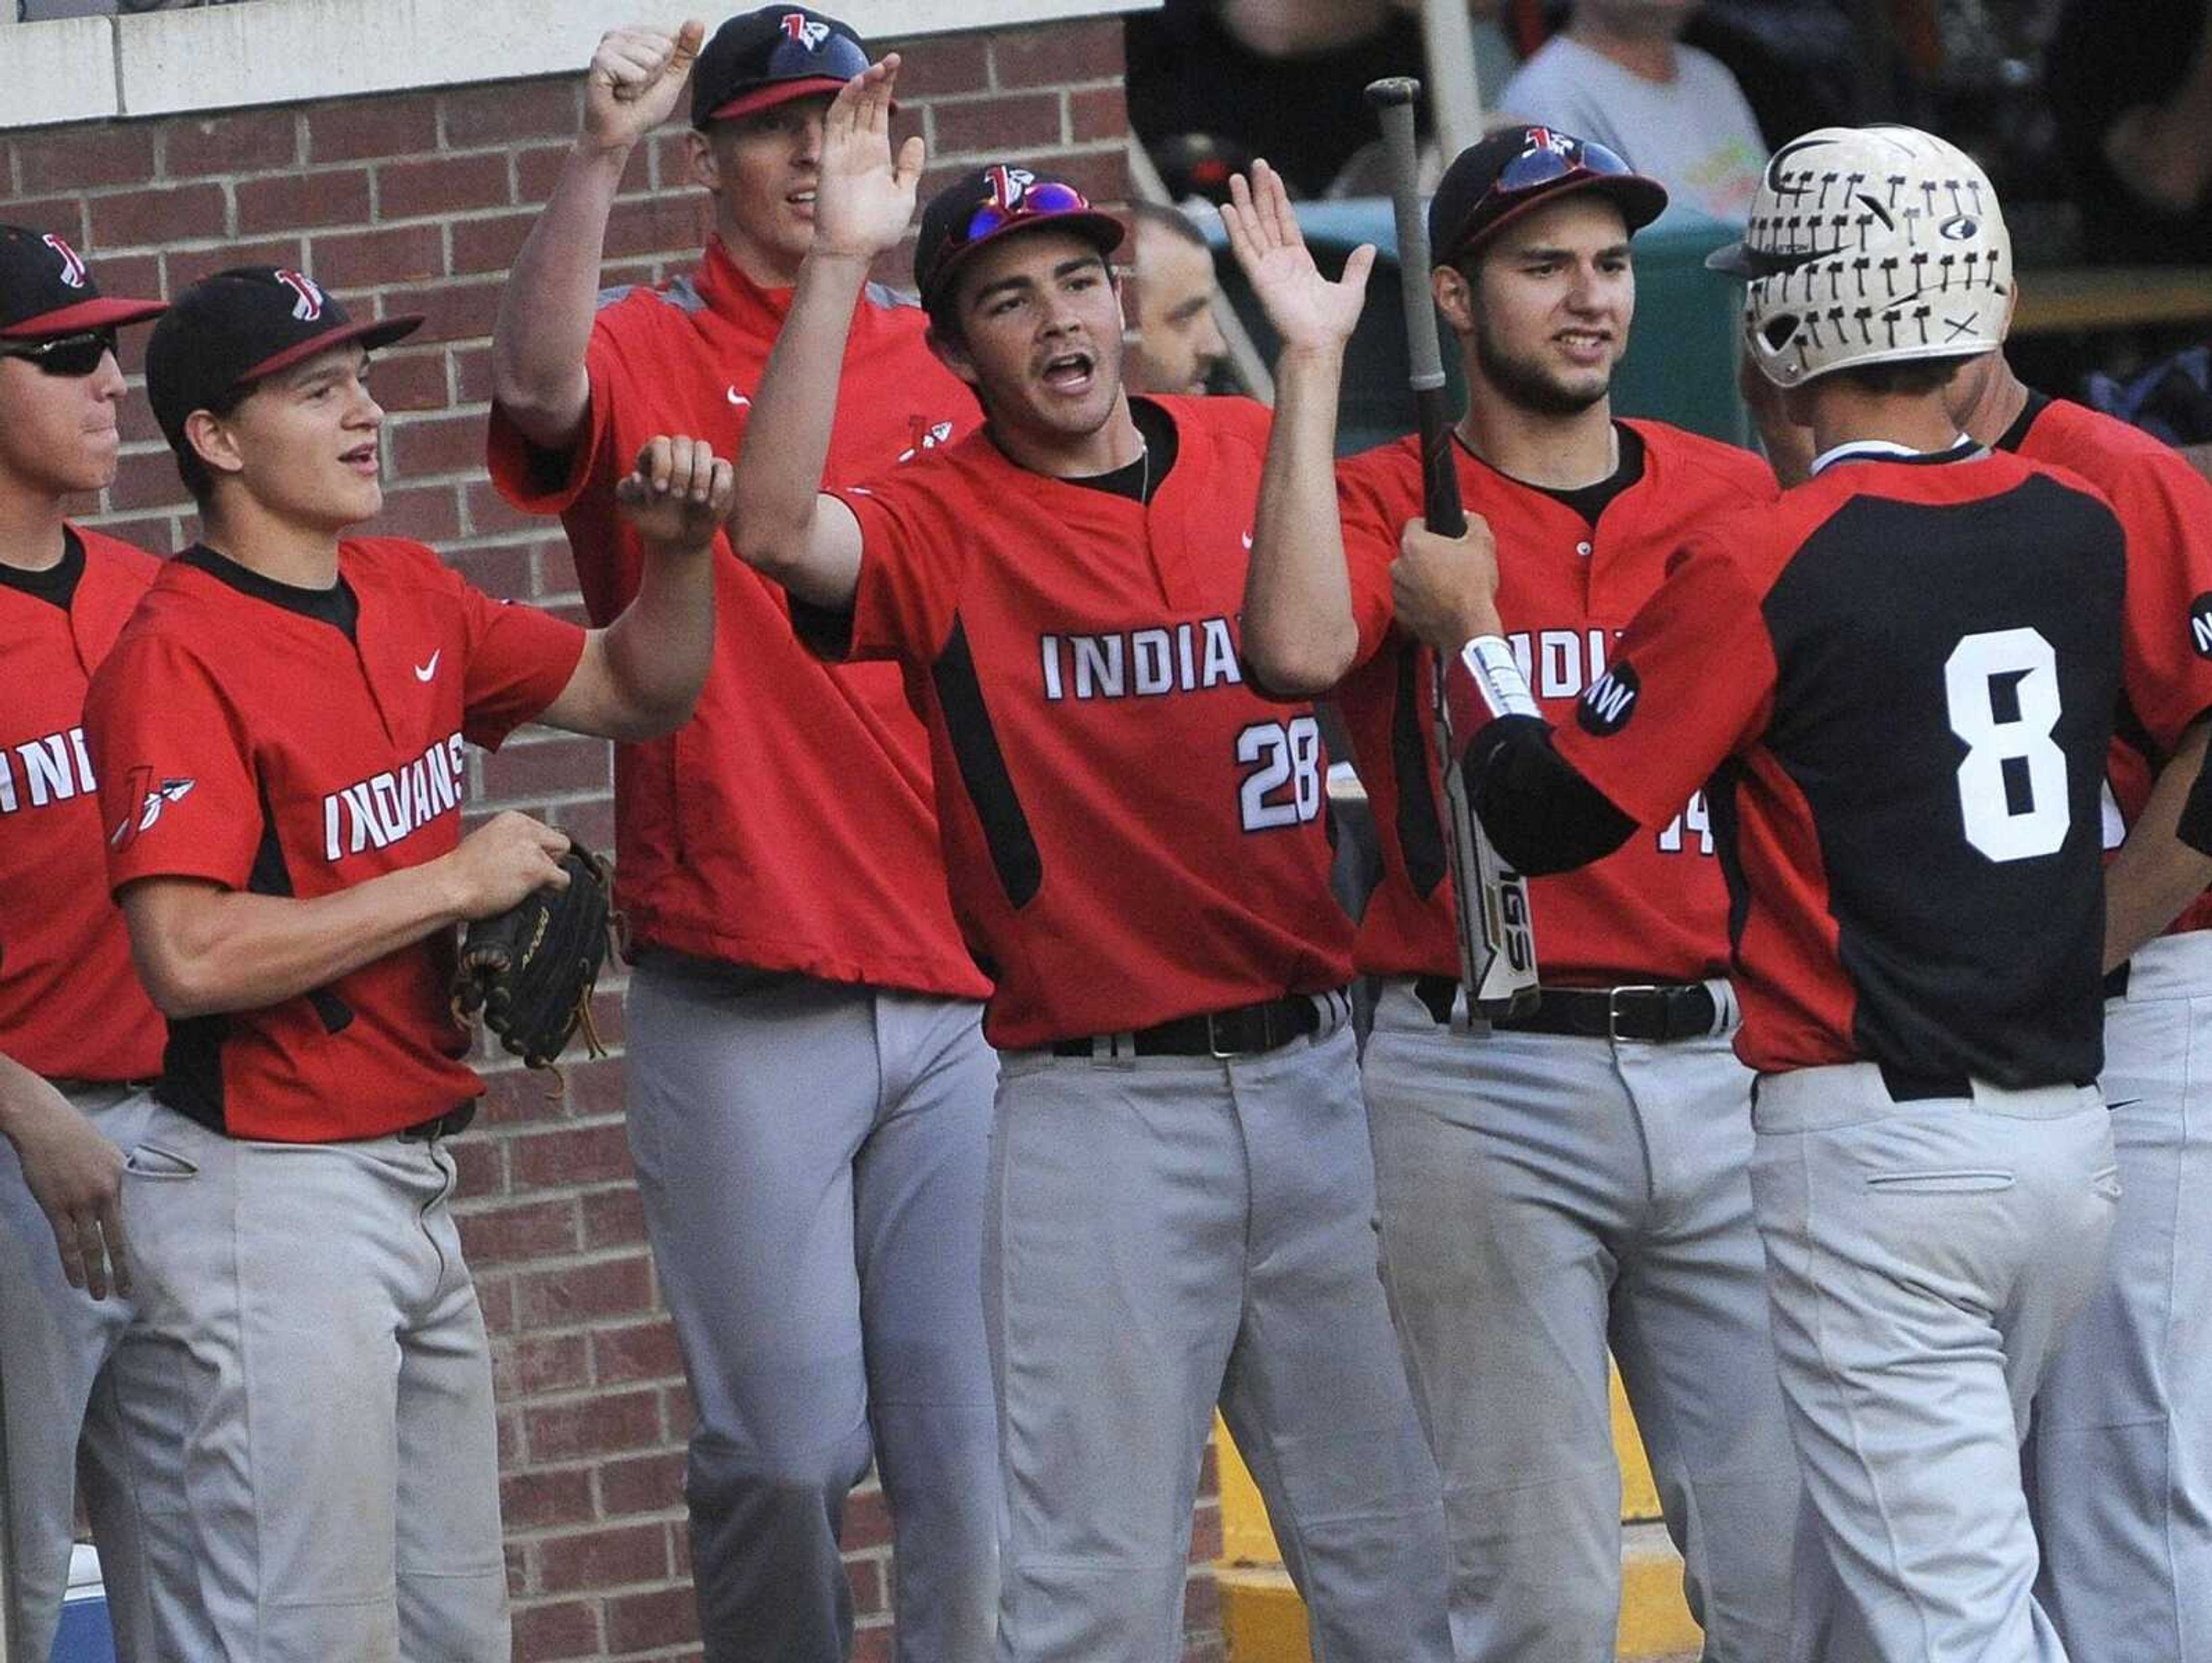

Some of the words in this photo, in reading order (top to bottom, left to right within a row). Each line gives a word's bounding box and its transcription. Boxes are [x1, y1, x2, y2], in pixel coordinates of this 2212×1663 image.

[1041, 616, 1243, 699] INDIA
[1236, 716, 1320, 832] 28
[1944, 626, 2070, 863] 8
